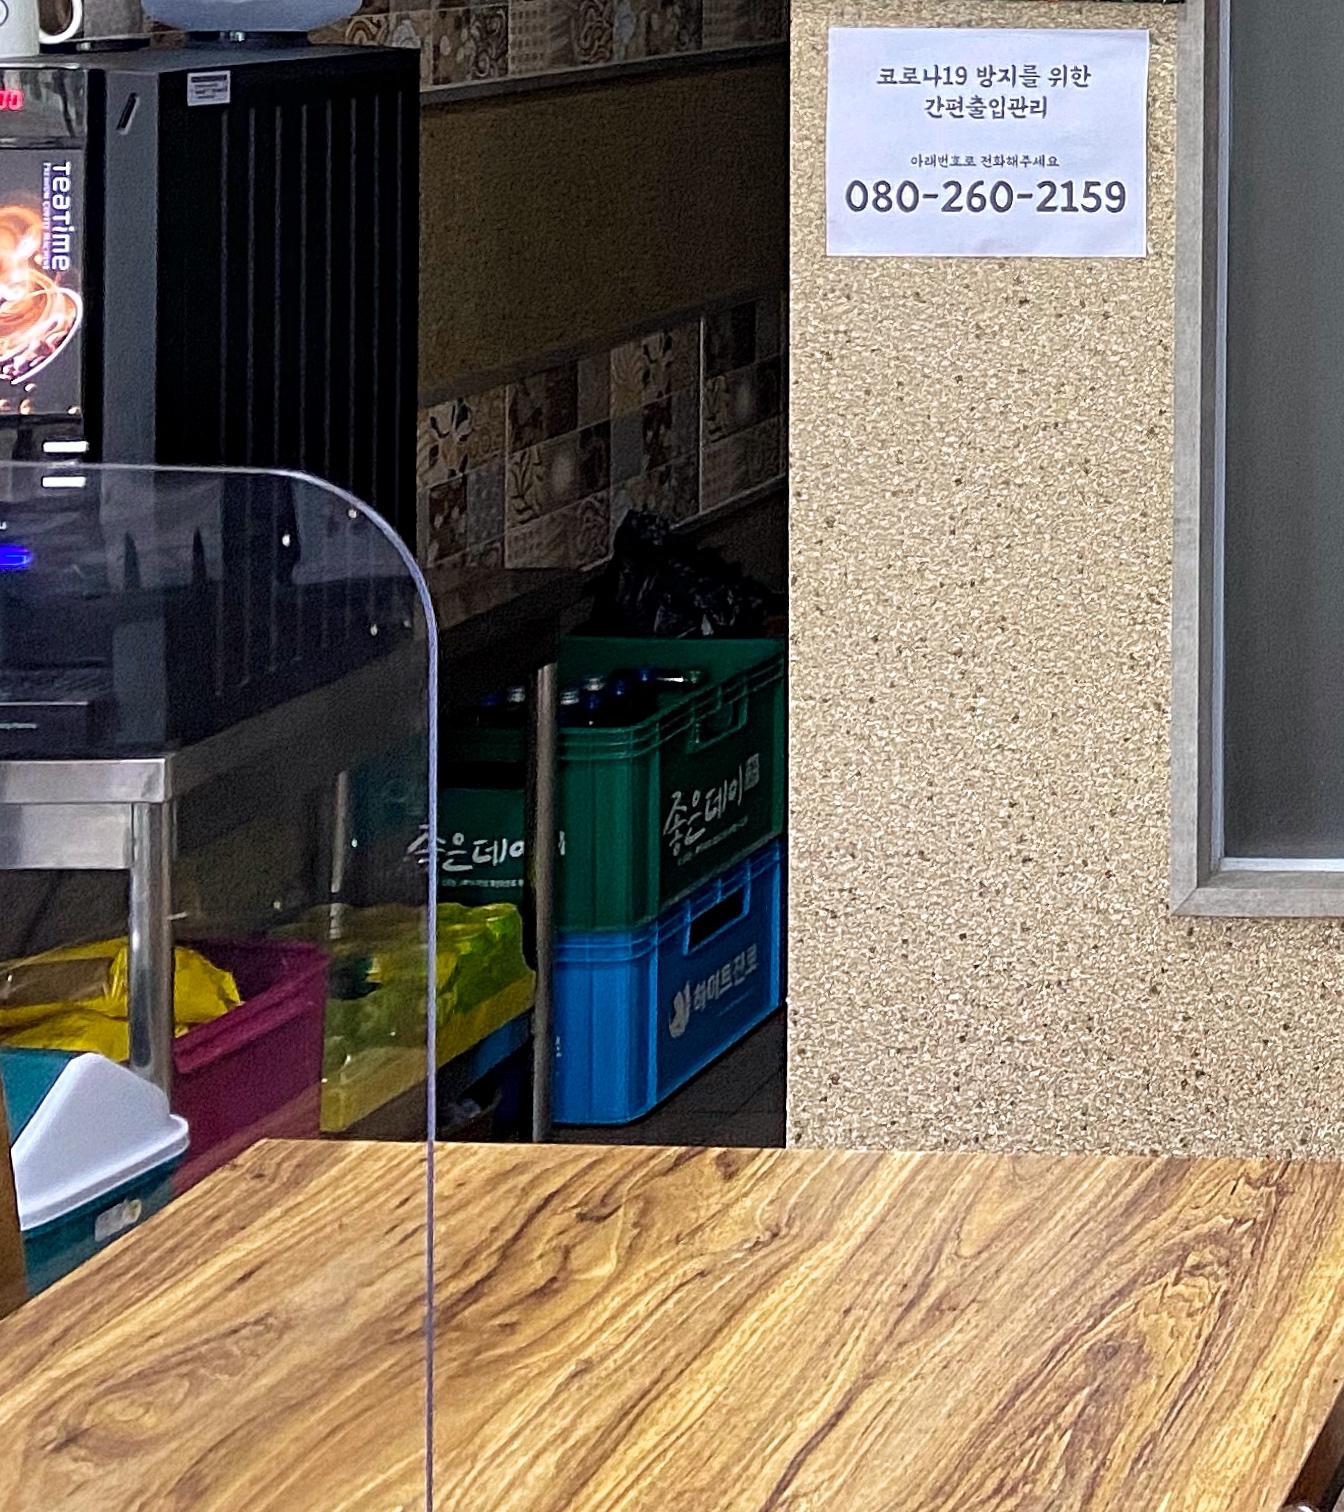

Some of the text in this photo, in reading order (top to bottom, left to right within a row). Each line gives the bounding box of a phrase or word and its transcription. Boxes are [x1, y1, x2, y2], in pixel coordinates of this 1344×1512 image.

[876, 64, 1092, 88] 코로나19 방지를 위한
[924, 94, 1048, 119] 간편출입관리
[911, 154, 1060, 168] 아래번호로 전화해주세요
[845, 180, 1127, 213] 080-260-2159
[663, 763, 743, 856] 좋은데이
